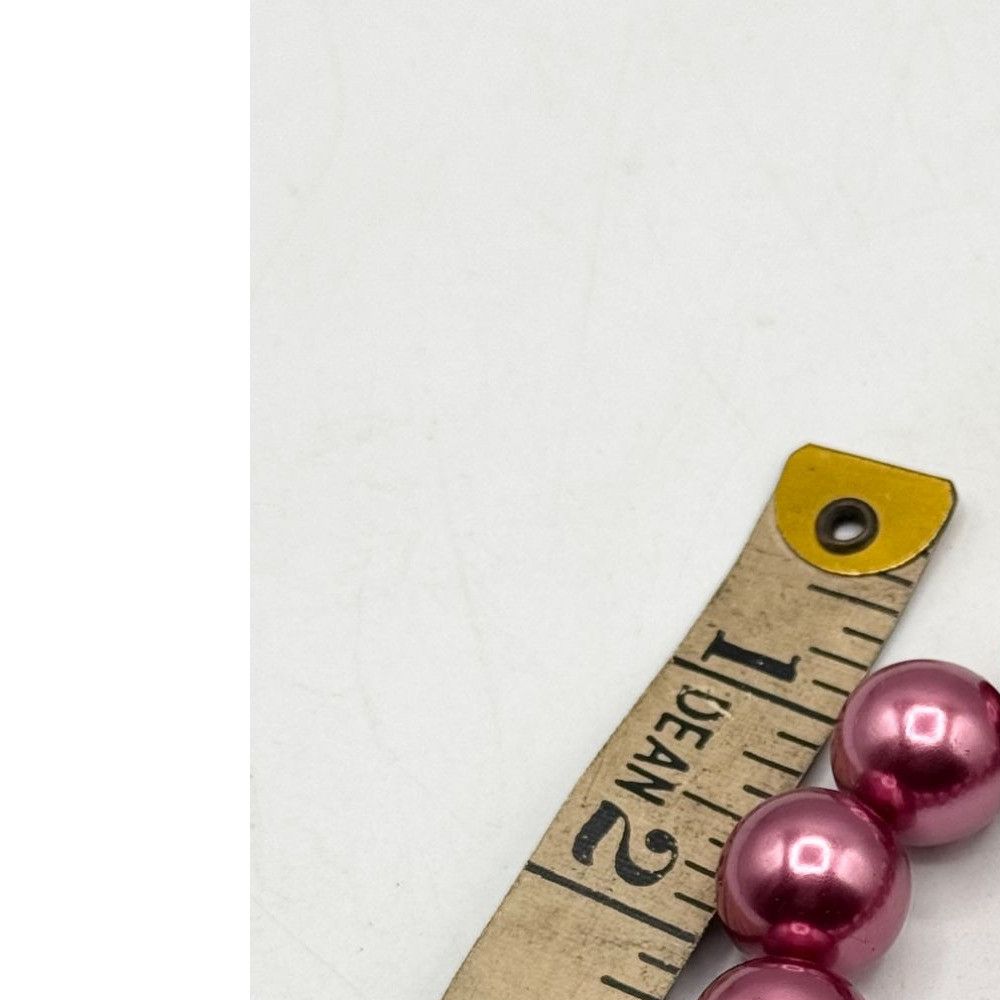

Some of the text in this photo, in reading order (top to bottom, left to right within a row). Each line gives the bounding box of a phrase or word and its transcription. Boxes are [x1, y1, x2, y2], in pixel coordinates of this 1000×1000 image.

[701, 630, 801, 683] 1
[614, 685, 731, 806] DEAN
[572, 800, 679, 887] 2
